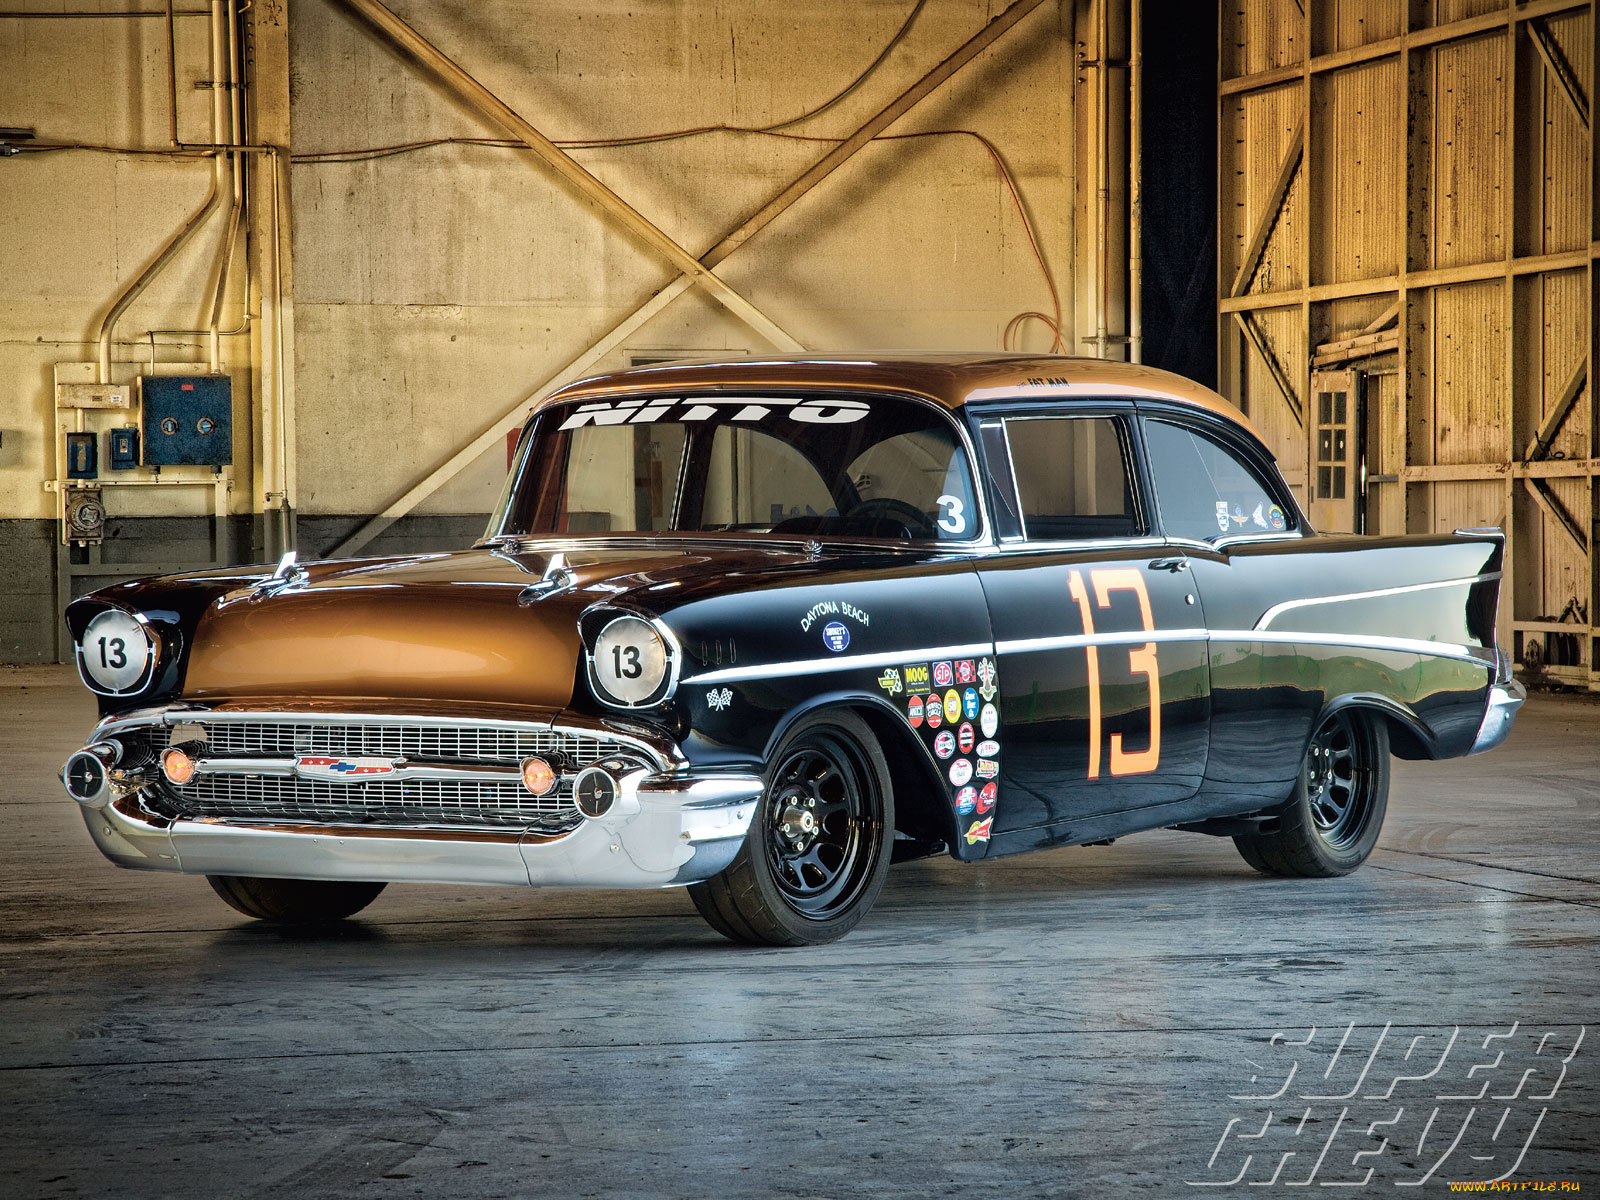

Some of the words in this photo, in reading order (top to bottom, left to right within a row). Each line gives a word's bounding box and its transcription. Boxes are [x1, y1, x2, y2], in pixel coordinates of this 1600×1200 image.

[557, 397, 871, 431] NITTO
[936, 495, 966, 534] 3
[800, 600, 840, 632] DAYTONA
[841, 601, 870, 627] BEACH
[97, 636, 127, 669] 13
[611, 645, 643, 679] 13
[905, 667, 928, 683] MOOG
[936, 665, 950, 681] STP
[1067, 568, 1161, 780] 13
